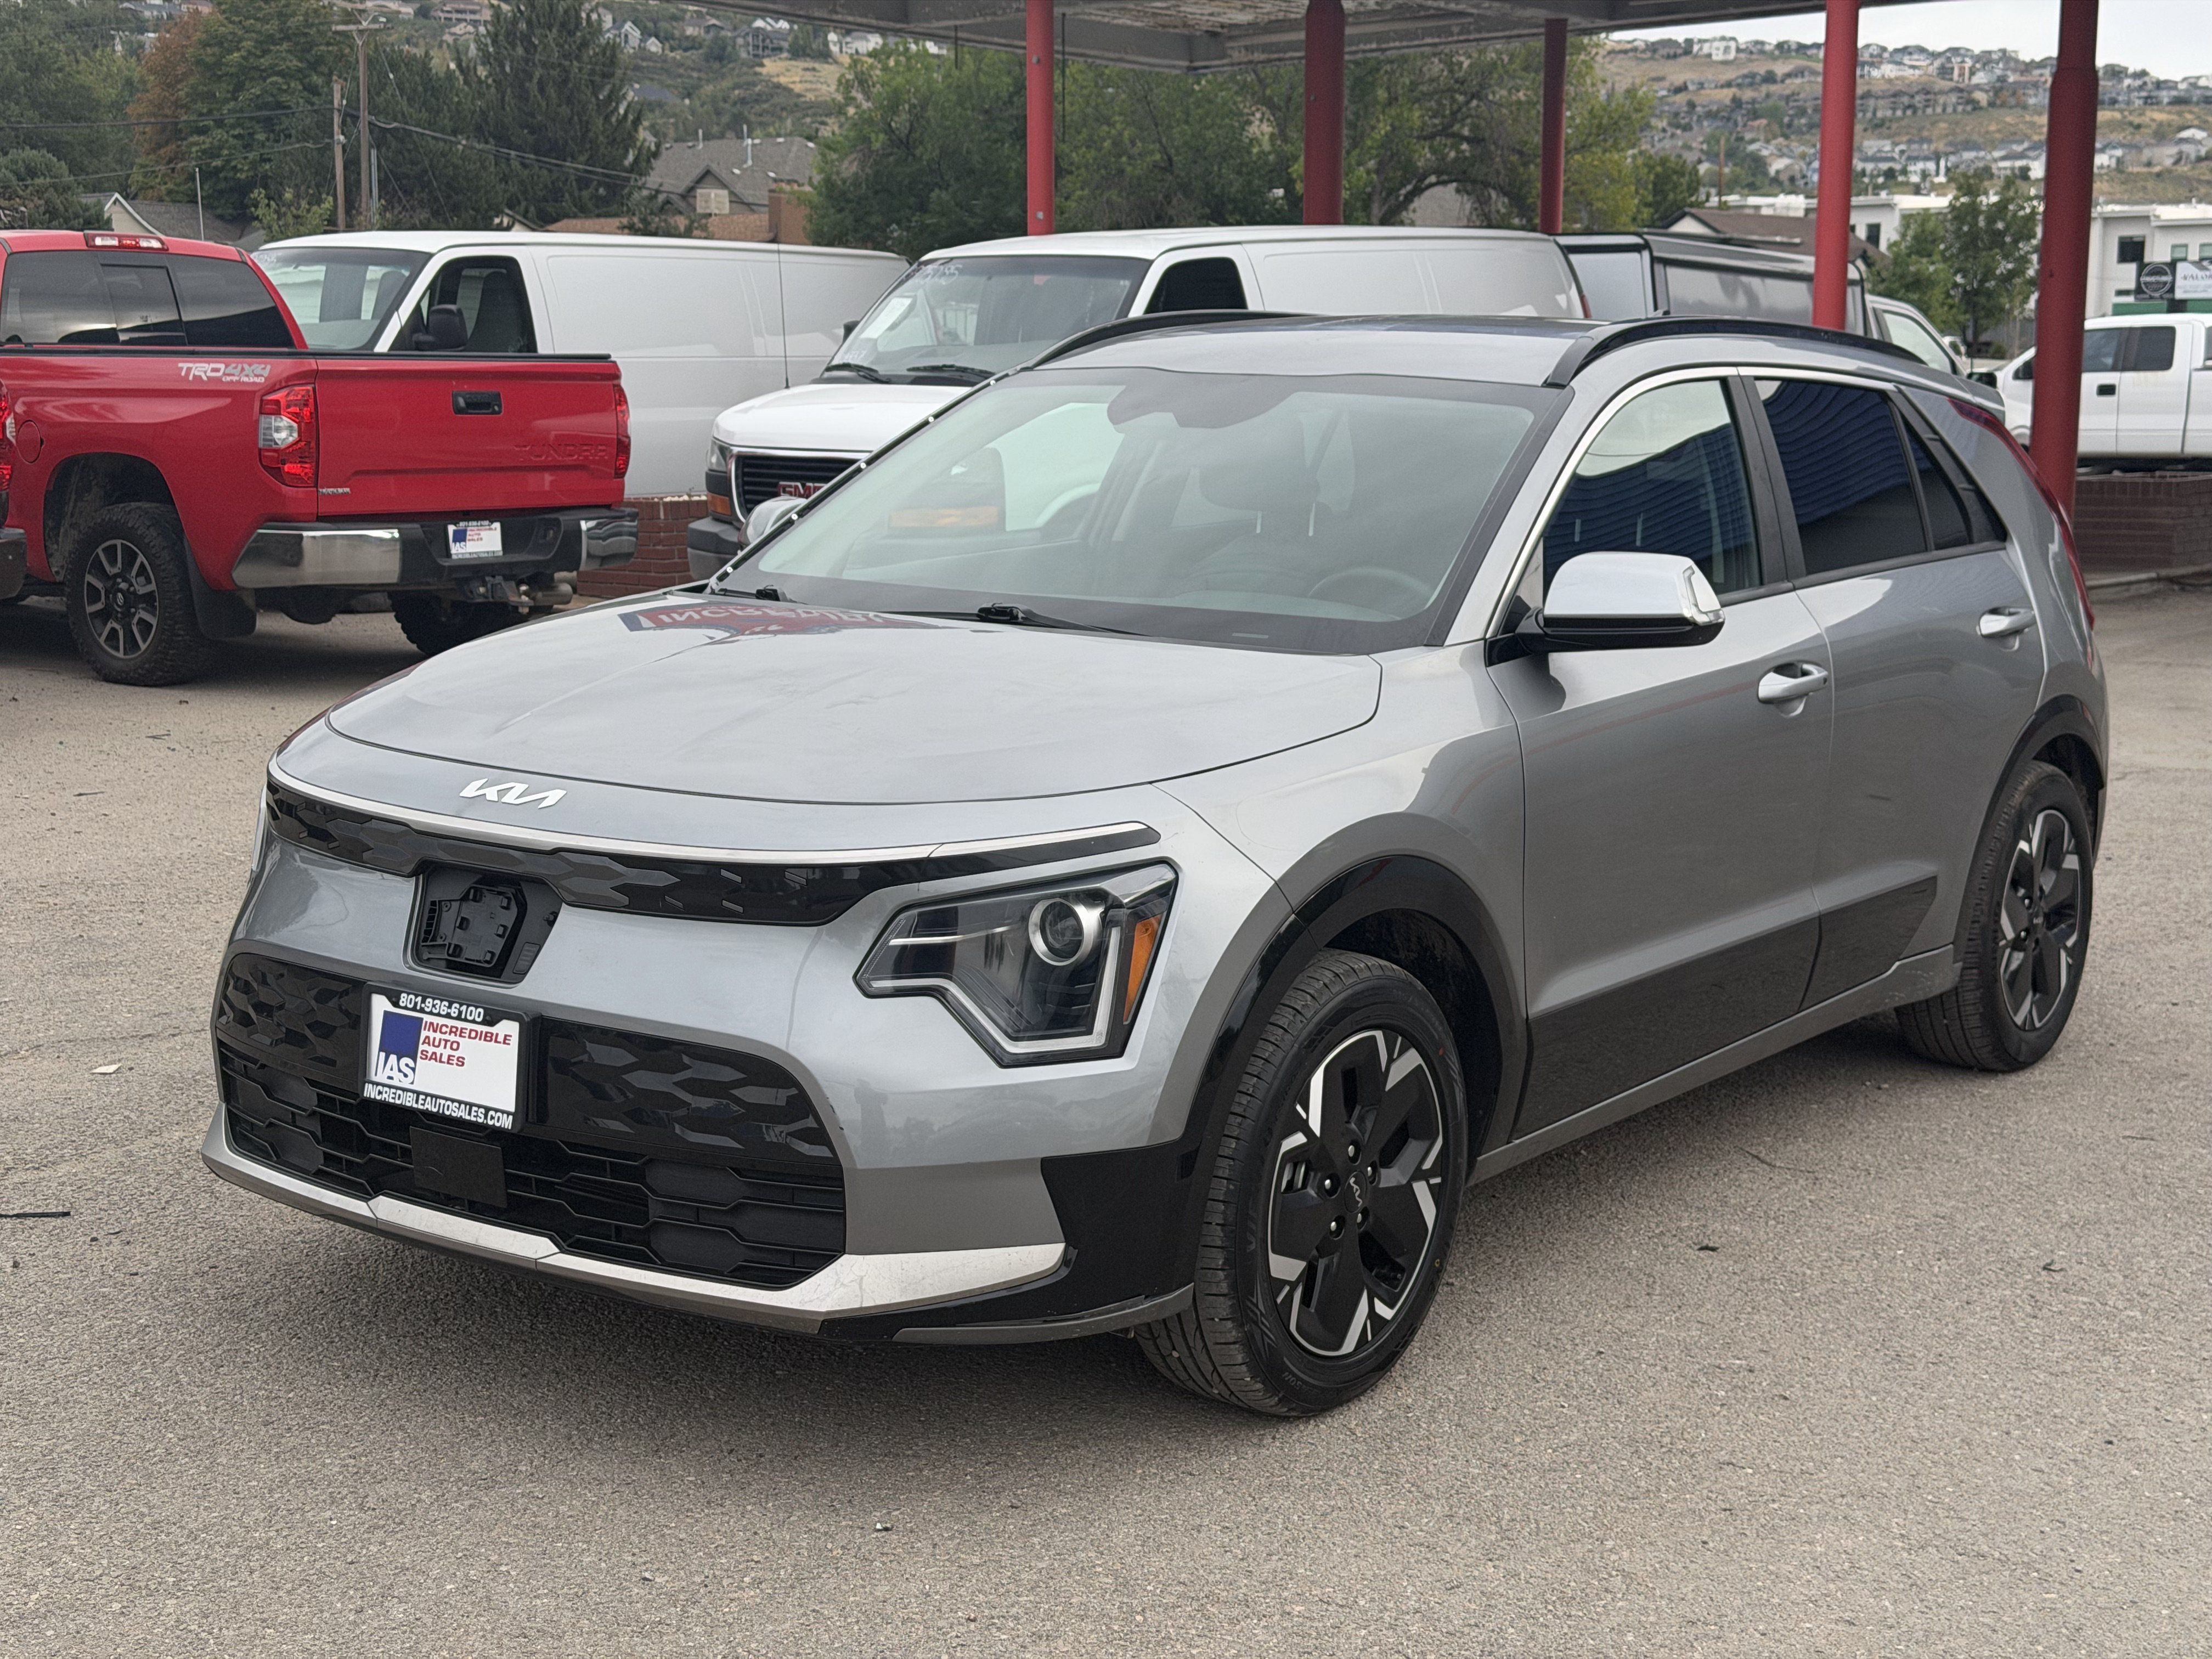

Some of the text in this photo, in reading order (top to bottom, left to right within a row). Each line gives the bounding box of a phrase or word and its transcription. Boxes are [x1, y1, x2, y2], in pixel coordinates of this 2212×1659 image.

[514, 443, 608, 460] TUNDRA
[460, 778, 567, 809] KIA
[399, 993, 484, 1022] 801-936-6100
[421, 1035, 461, 1052] AUTO
[423, 1020, 513, 1046] INCREDIBLE
[376, 1051, 415, 1085] IAS
[419, 1049, 466, 1067] SALES
[363, 1082, 514, 1130] INCREDIBLEAUTOSALES.COM
